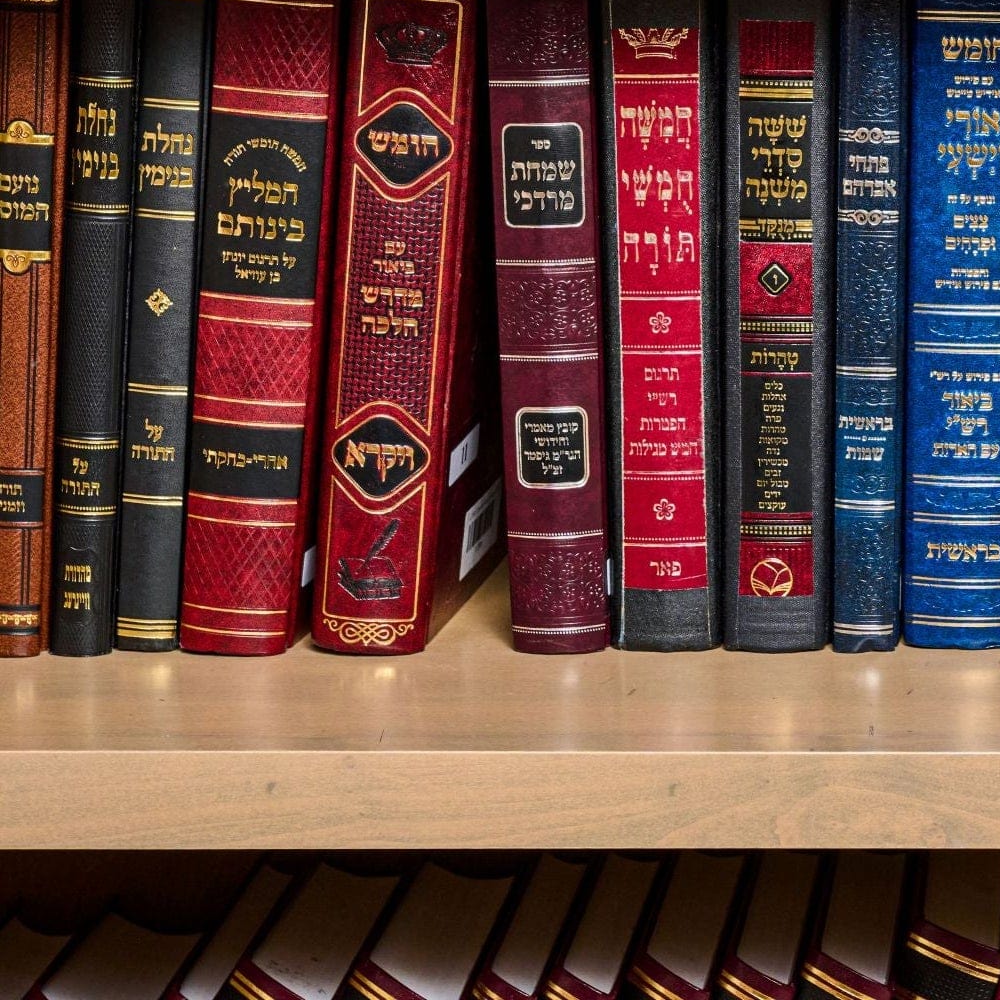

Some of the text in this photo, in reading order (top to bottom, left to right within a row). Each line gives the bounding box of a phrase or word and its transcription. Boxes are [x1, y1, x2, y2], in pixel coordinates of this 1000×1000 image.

[77, 102, 117, 137] נחלת
[142, 122, 194, 155] נחלת
[368, 130, 439, 157] חומש
[530, 138, 552, 150] ספר
[223, 138, 307, 172] חמשה חומשי תורה
[849, 154, 890, 174] פתחי
[72, 149, 120, 185] בנימין
[510, 159, 576, 182] שמחת
[138, 163, 194, 192] בנימין
[228, 168, 299, 207] המליץ
[842, 178, 898, 198] אברהם
[513, 189, 576, 212] מרדכי
[217, 211, 306, 242] בינותם
[384, 241, 408, 257] עם
[248, 252, 280, 266] תרגום
[282, 251, 297, 269] על
[372, 259, 416, 275] ביאור
[269, 271, 281, 285] בן
[360, 285, 424, 308] מדרש
[360, 309, 420, 337] הלכה
[644, 367, 680, 382] תרגום
[764, 380, 784, 390] כלים
[761, 391, 787, 401] אהלות
[942, 390, 993, 411] ביאור
[639, 416, 687, 431] הפטרות
[765, 415, 782, 423] פרה
[838, 414, 894, 431] בראשית
[945, 414, 990, 436] רש"י
[145, 417, 164, 442] על
[131, 444, 176, 462] התורה
[629, 438, 668, 456] מגילות
[845, 446, 885, 461] שמות
[979, 442, 1000, 460] עם
[72, 457, 89, 475] על
[344, 439, 415, 483] ויקרא
[61, 478, 101, 497] התורה
[649, 560, 682, 577] פאר
